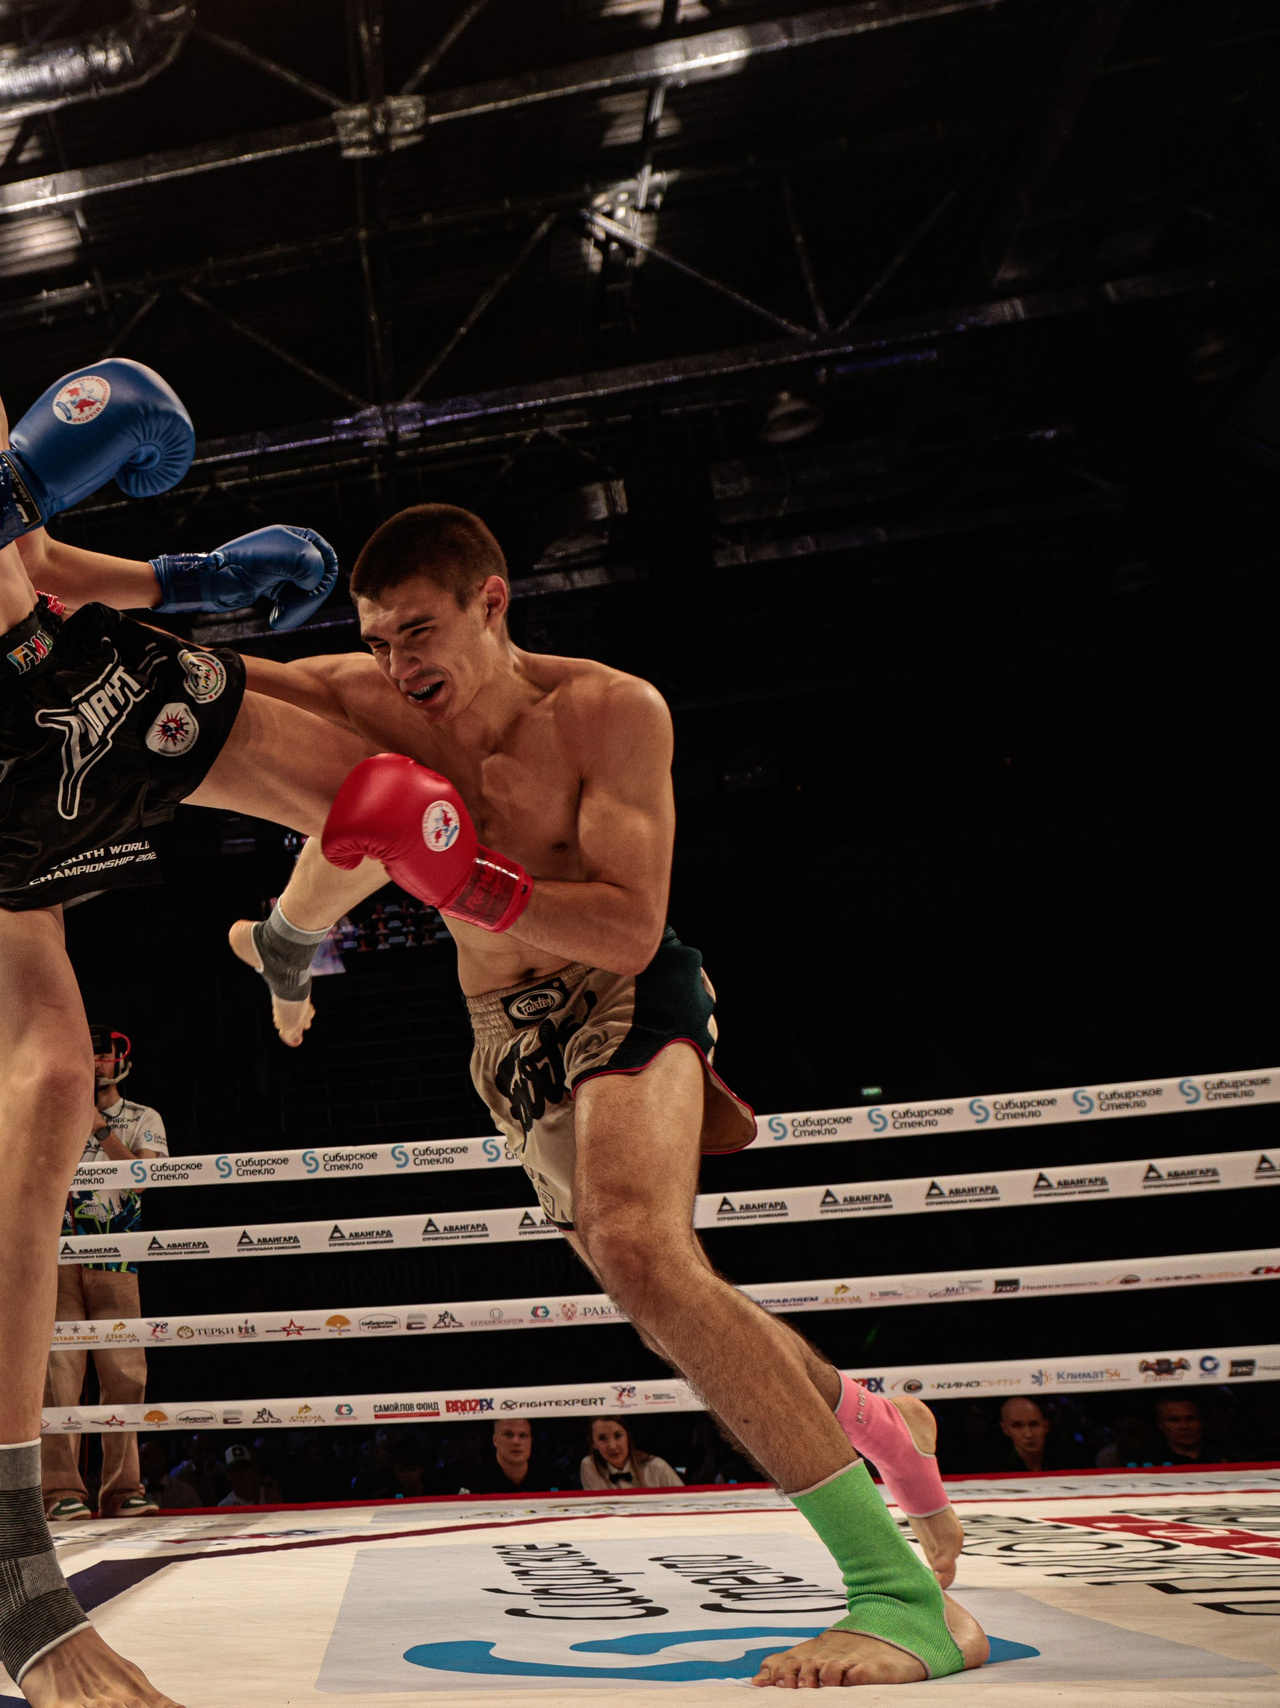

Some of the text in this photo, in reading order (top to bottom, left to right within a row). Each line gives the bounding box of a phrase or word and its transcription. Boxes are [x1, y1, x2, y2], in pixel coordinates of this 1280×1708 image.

[50, 848, 104, 870] OUTH
[29, 856, 135, 885] CHAMPIONSHIP
[517, 994, 554, 1016] Fairtex
[1204, 1076, 1271, 1090] Сибирское
[1097, 1086, 1162, 1100] Сибирское
[1206, 1088, 1254, 1101] Стекло
[994, 1097, 1057, 1110] Сибирское
[1100, 1099, 1146, 1112] Стекло
[892, 1106, 953, 1119] Сибирское
[995, 1109, 1041, 1121] Стекло
[792, 1115, 853, 1128] Сибирское
[893, 1118, 938, 1129] Стекло
[793, 1126, 837, 1138] Стекло
[323, 1151, 377, 1163] Сибирское
[413, 1145, 468, 1158] Сибирское
[236, 1157, 289, 1168] Сибирское
[324, 1161, 363, 1171] Стекло
[413, 1156, 454, 1166] Стекло
[74, 1167, 117, 1176] ибирское
[151, 1163, 202, 1172] Сибирское
[236, 1166, 275, 1176] Стекло
[151, 1172, 189, 1181] Стекло
[949, 1185, 1000, 1195] АВАНГАРД
[843, 1193, 892, 1203] АВАНГАРД
[739, 1201, 787, 1210] АВАНГАРД
[443, 1223, 488, 1231] АВАНГАРД
[349, 1230, 393, 1238] АВАНГАРД
[167, 1241, 209, 1249] АВАНГАРД
[257, 1236, 300, 1244] АВАНГАРД
[1057, 1369, 1120, 1380] Климат54
[374, 1402, 439, 1413] САМОЙЛОВ ФОНД
[519, 1397, 606, 1408] FIGHTEXPERT
[481, 1543, 669, 1620] Сибирское
